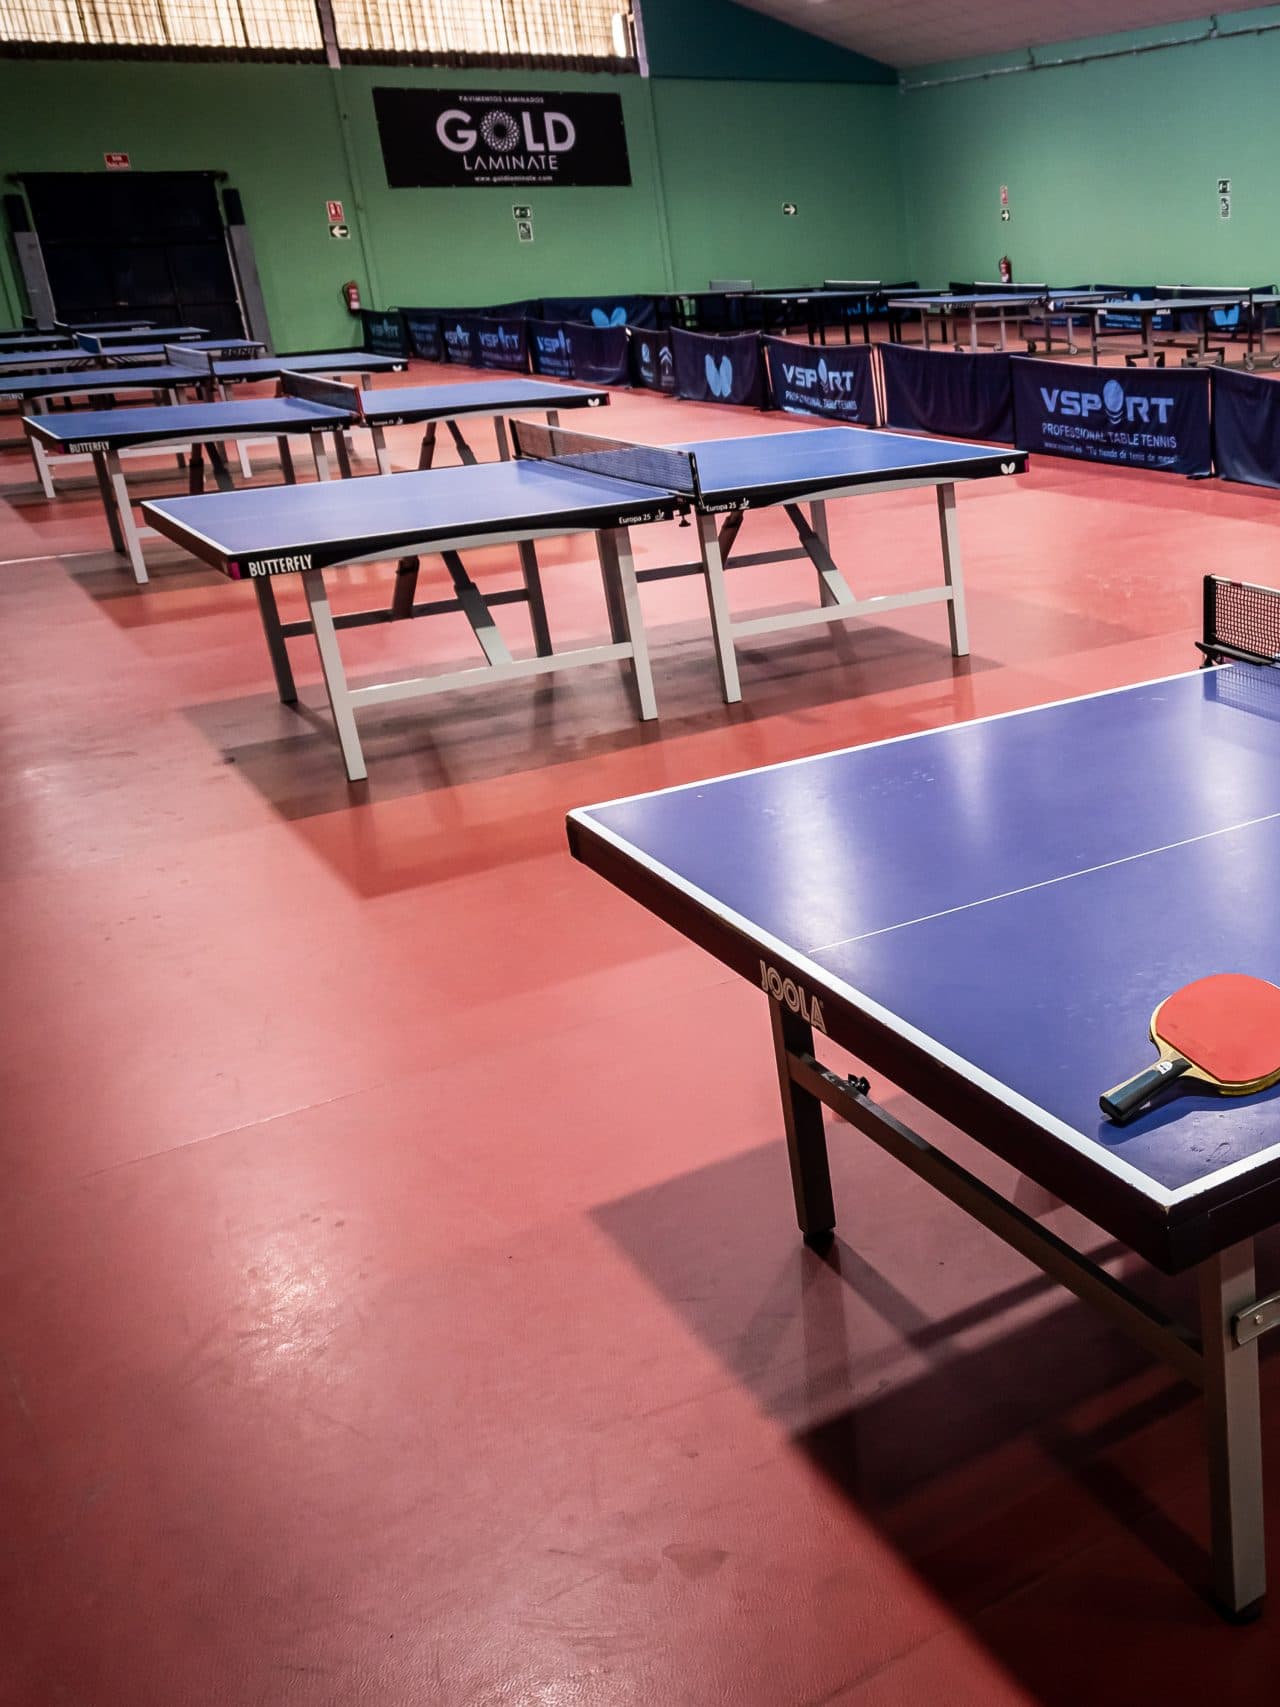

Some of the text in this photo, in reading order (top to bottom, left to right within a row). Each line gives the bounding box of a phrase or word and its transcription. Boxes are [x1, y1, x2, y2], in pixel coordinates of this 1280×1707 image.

[436, 109, 576, 152] GOLD
[463, 154, 558, 170] LAMINATE
[782, 358, 854, 392] VSPORT
[1040, 379, 1174, 424] VSPORT
[69, 440, 109, 453] BUTTERFLY
[1042, 422, 1177, 449] PROFESSIONAL TABLE TENNIS
[618, 513, 651, 525] Europa 25
[706, 504, 728, 513] Europa
[248, 554, 312, 577] BUTTERFLY
[760, 959, 827, 1034] JOOLA
